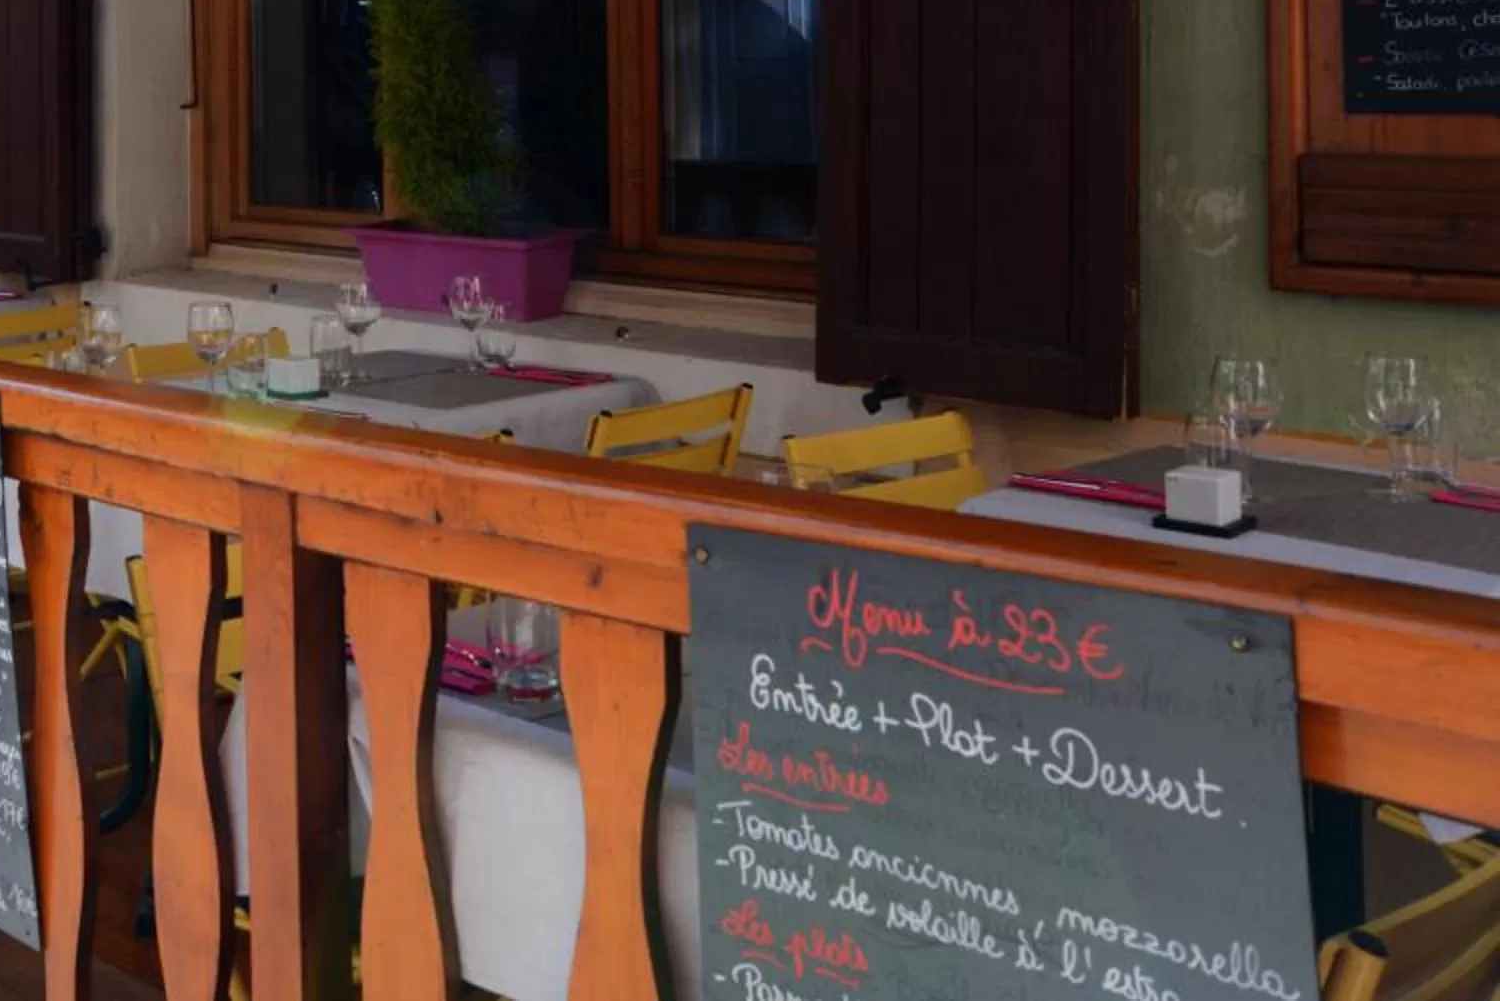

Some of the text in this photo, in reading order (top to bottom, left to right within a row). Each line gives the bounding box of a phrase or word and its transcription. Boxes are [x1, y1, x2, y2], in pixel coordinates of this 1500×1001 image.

[806, 568, 932, 668] Menu
[947, 591, 993, 649] à
[719, 721, 774, 781] Les
[750, 653, 863, 732] Entrée
[872, 701, 900, 735] +
[904, 692, 1000, 765] Plat
[1012, 735, 1040, 766] +
[719, 899, 870, 981] Les plats
[829, 877, 877, 916] de
[885, 900, 1006, 960] volaille
[1014, 929, 1046, 973] à
[1056, 906, 1302, 1001] mozzarella
